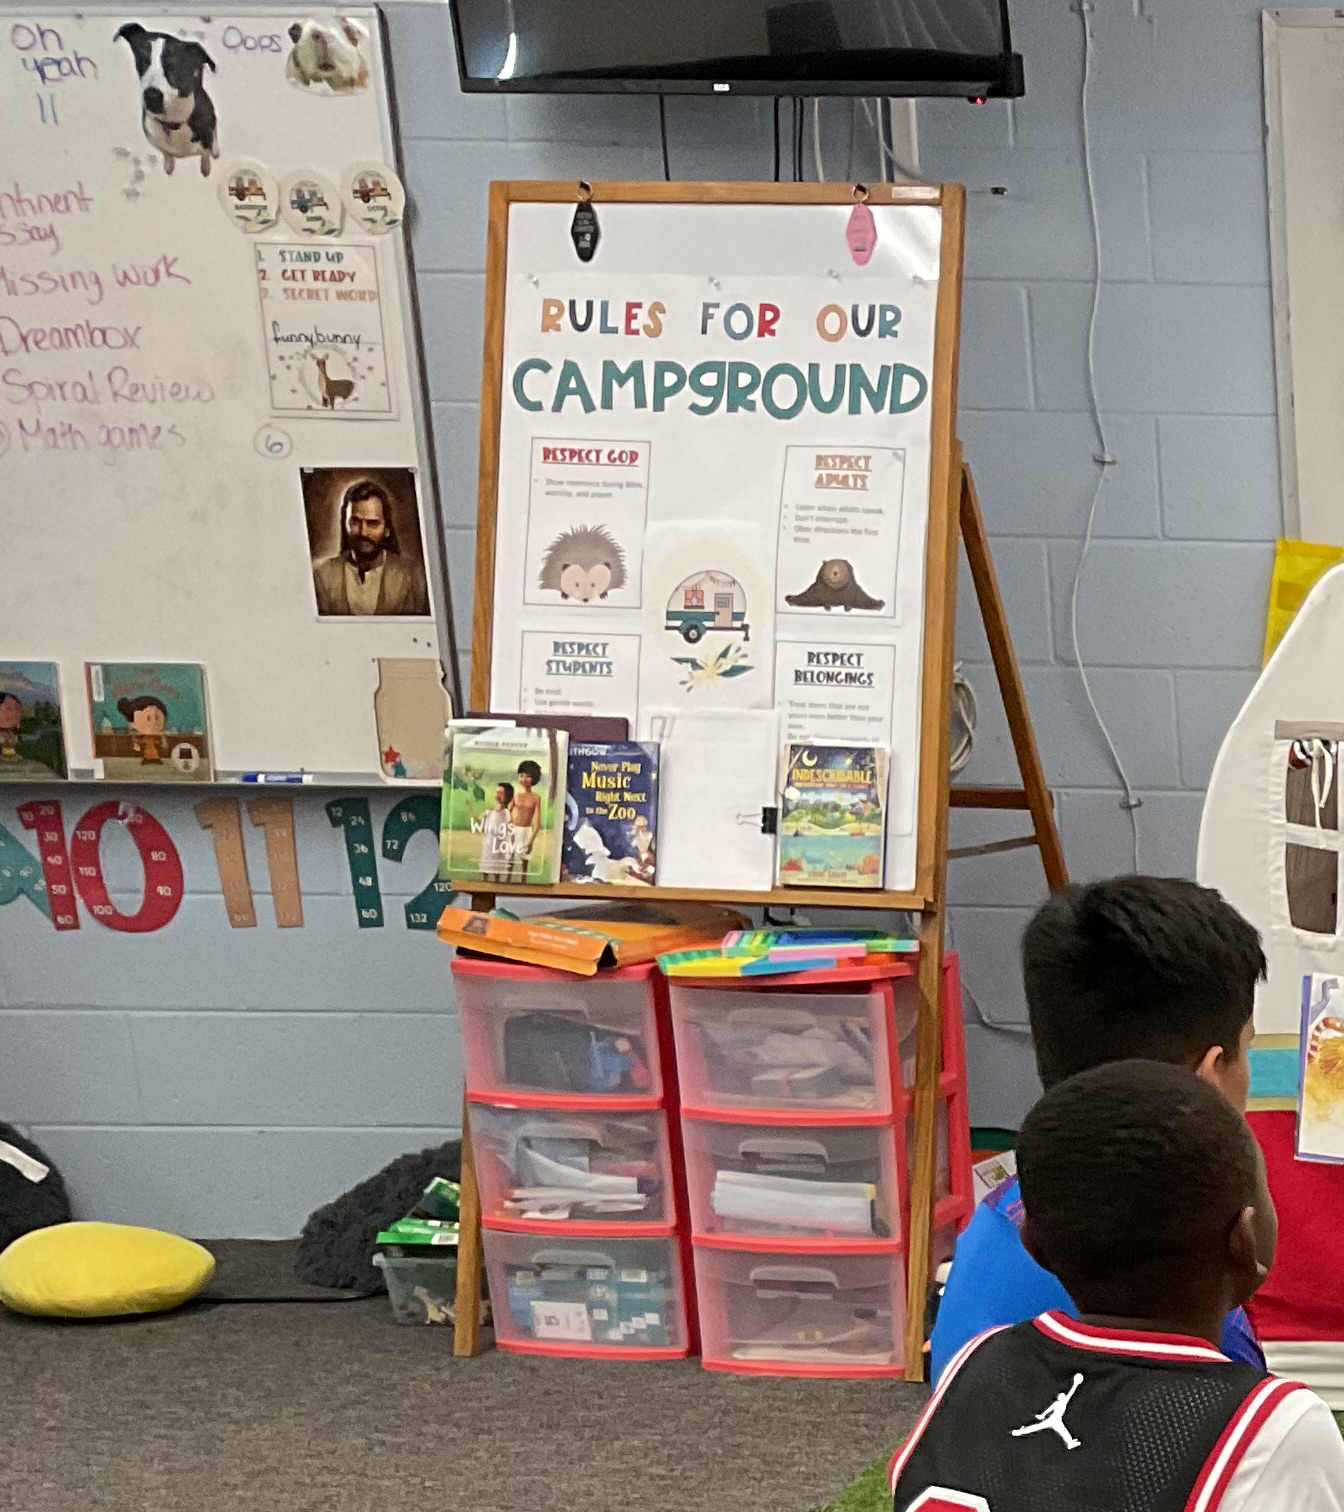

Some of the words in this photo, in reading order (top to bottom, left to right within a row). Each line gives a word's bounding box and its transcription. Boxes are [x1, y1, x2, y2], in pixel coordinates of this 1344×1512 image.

[11, 24, 62, 51] Oh
[222, 26, 282, 53] Oops
[22, 56, 97, 83] yeah
[278, 250, 321, 263] STAND
[326, 252, 344, 264] UP
[281, 269, 306, 282] GET
[312, 270, 356, 283] READY
[541, 298, 667, 338] RULES
[701, 302, 782, 341] FOR
[816, 303, 903, 343] OUR
[0, 316, 141, 356] Dreambox
[2, 368, 97, 414] Spiral
[107, 366, 215, 404] Review
[18, 418, 86, 451] Math
[543, 447, 602, 463] RESPECT
[607, 449, 639, 464] GOD
[815, 455, 872, 470] RESPECT
[552, 641, 608, 657] RESPECT
[807, 651, 864, 668] RESPECT
[546, 660, 614, 677] STUDENTS
[794, 670, 875, 688] BELONGINGS
[591, 761, 619, 772] Never
[582, 772, 631, 789] Music
[608, 804, 636, 820] Zoo
[470, 817, 514, 838] Wings
[492, 837, 525, 854] Love
